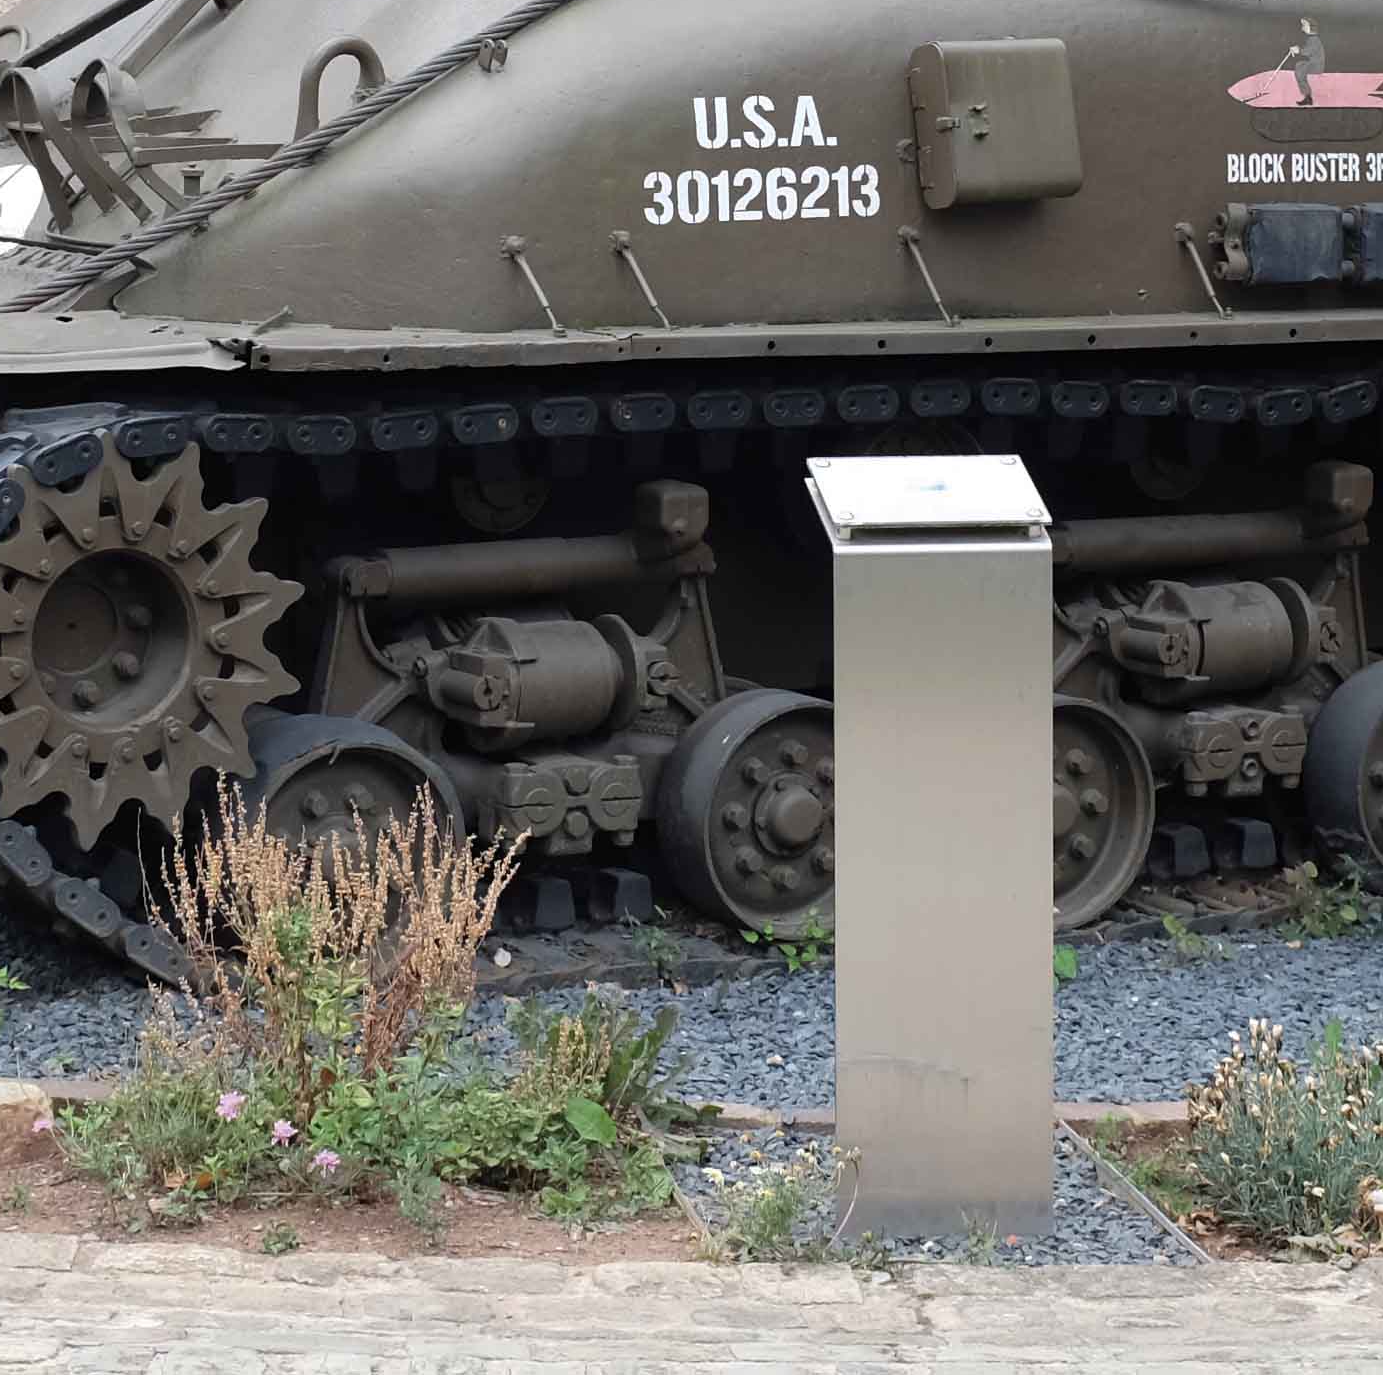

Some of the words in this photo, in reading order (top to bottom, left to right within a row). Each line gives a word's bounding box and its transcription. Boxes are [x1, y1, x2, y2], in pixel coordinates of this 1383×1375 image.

[692, 95, 838, 150] U.S.A.
[643, 164, 881, 225] 30126213
[1227, 152, 1286, 184] BLOCK
[1291, 152, 1360, 183] BUSTER
